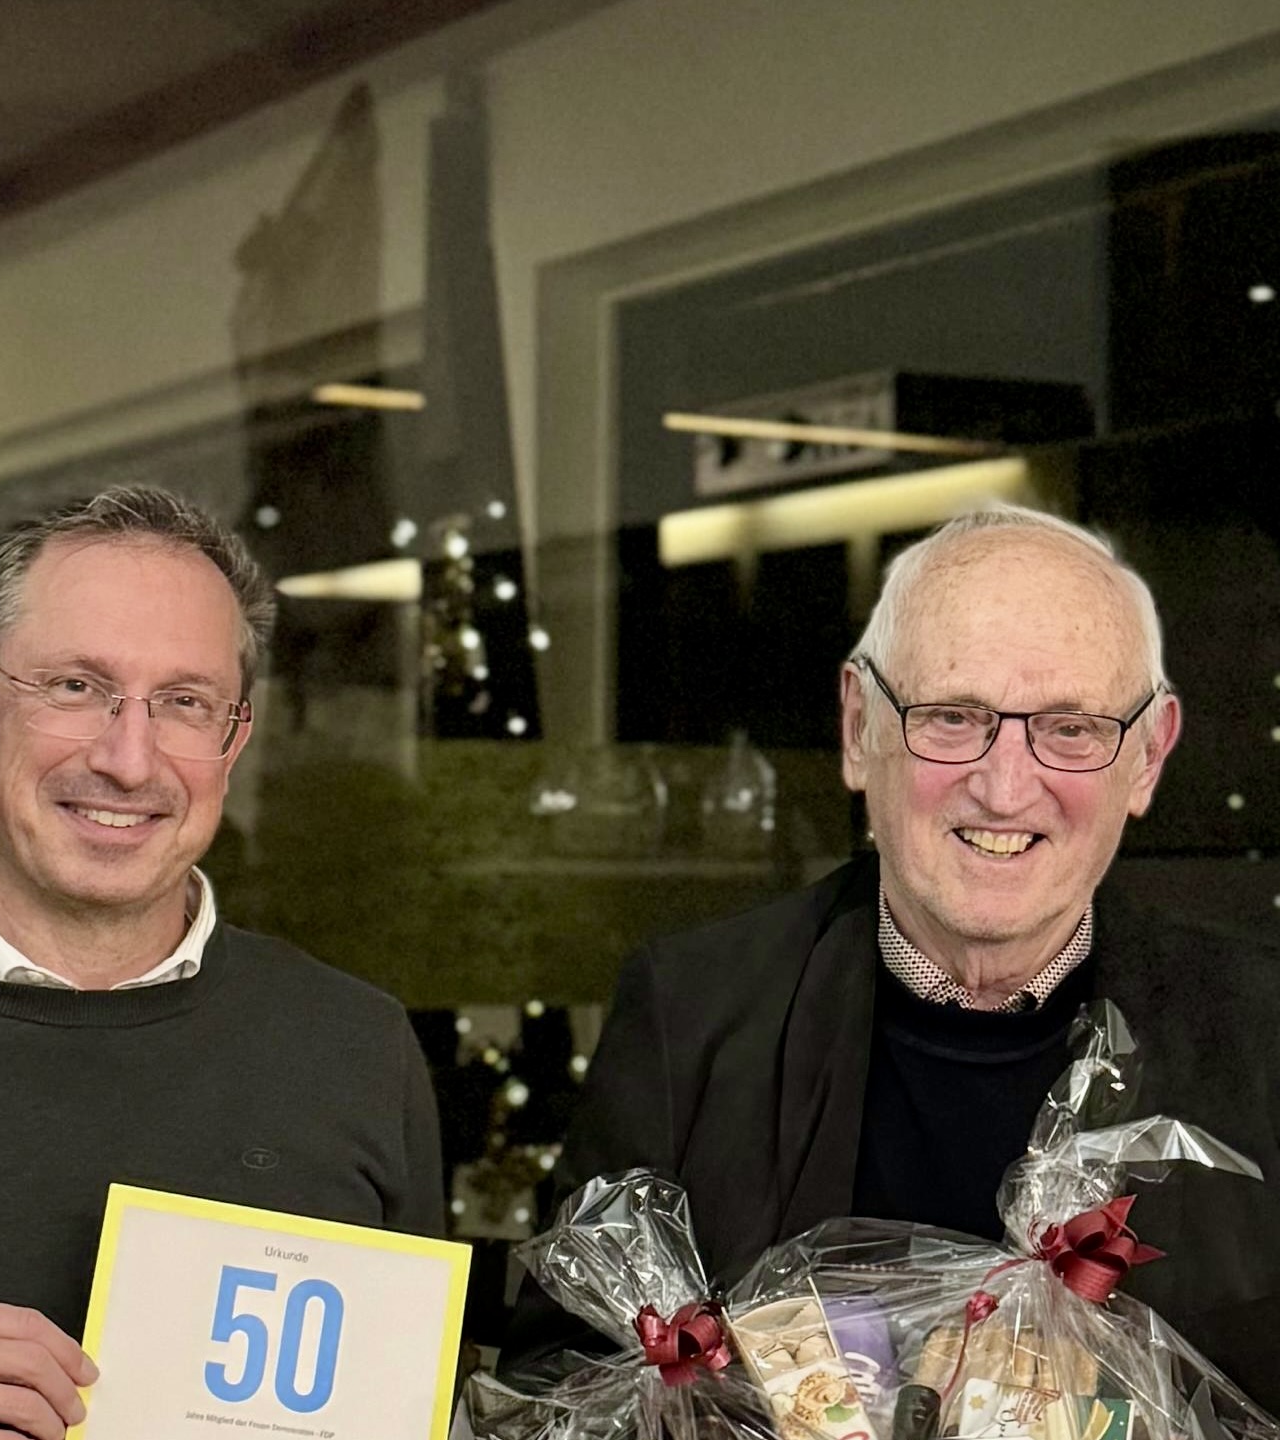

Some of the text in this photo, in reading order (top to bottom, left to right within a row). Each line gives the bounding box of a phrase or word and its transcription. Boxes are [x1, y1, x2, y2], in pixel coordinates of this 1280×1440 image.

[264, 1246, 309, 1264] Urkunde
[204, 1264, 345, 1414] 50
[320, 1429, 335, 1439] FDP
